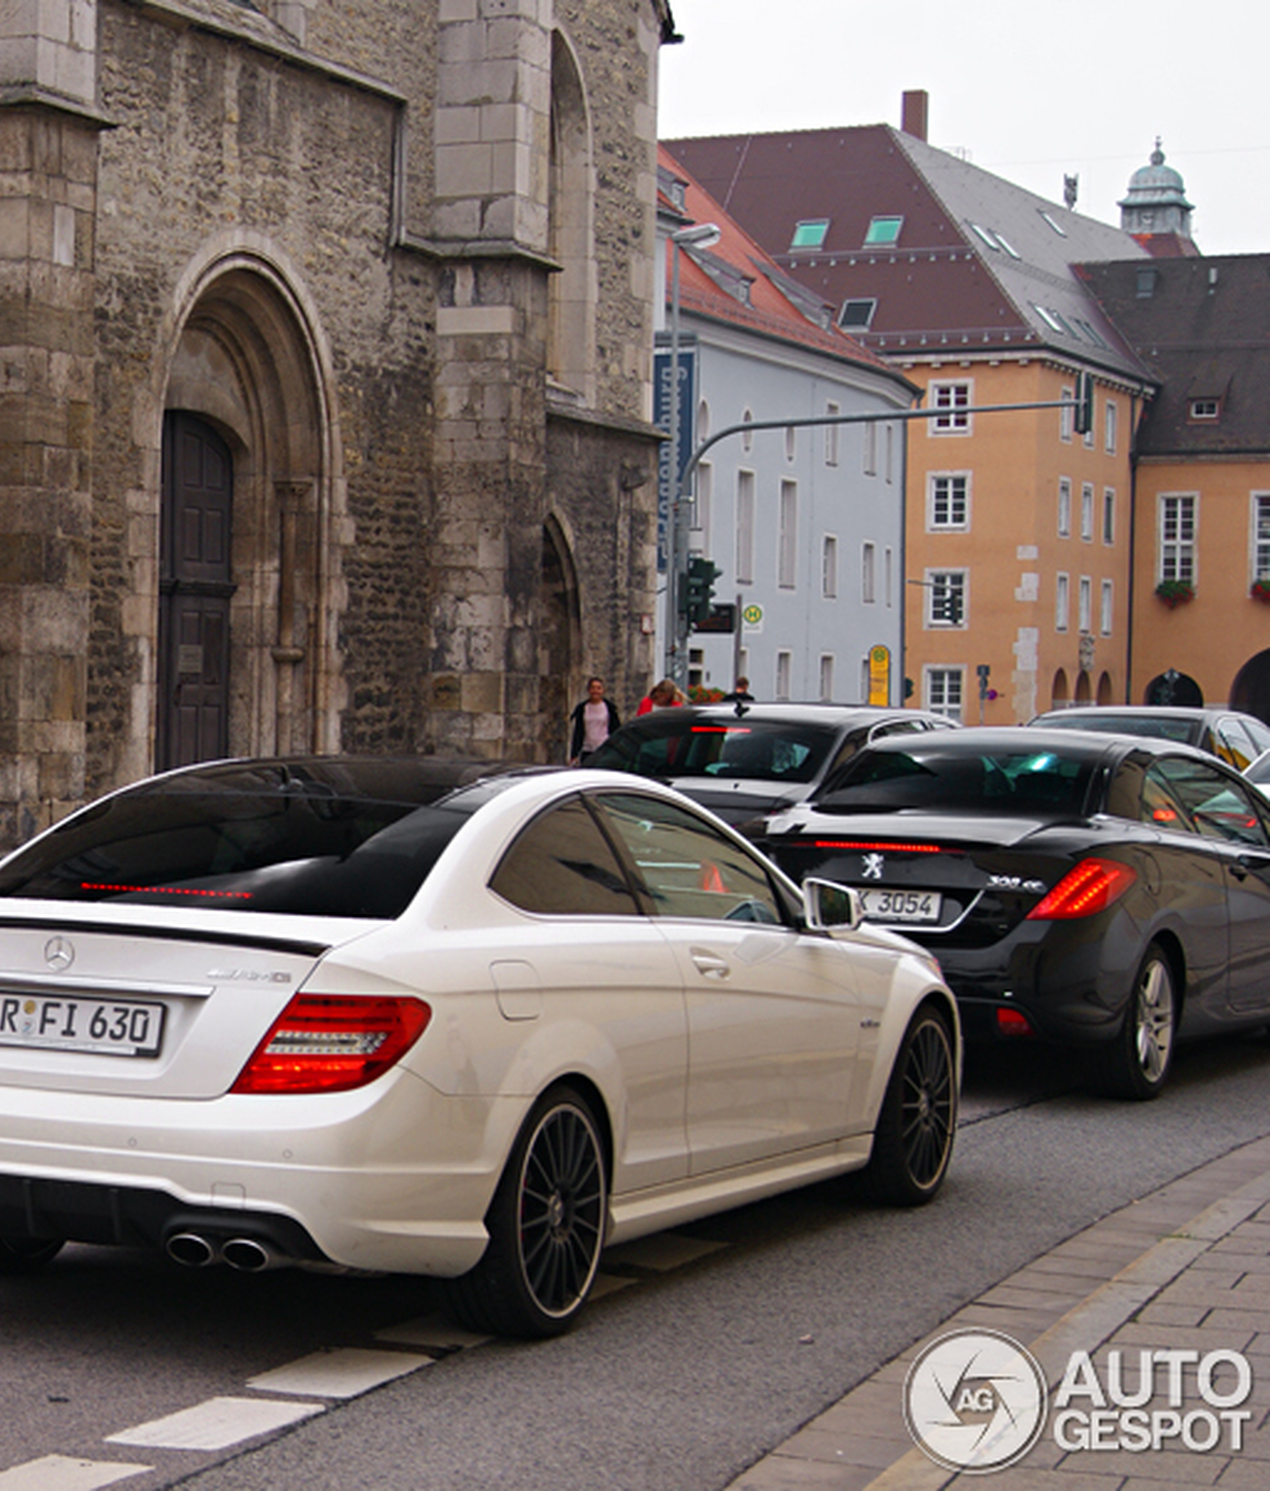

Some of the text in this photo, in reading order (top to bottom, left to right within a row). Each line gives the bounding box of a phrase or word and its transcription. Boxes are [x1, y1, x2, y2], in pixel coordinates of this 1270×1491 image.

[987, 875, 1021, 889] 308
[877, 892, 932, 915] 3054
[0, 998, 150, 1043] R FI 630
